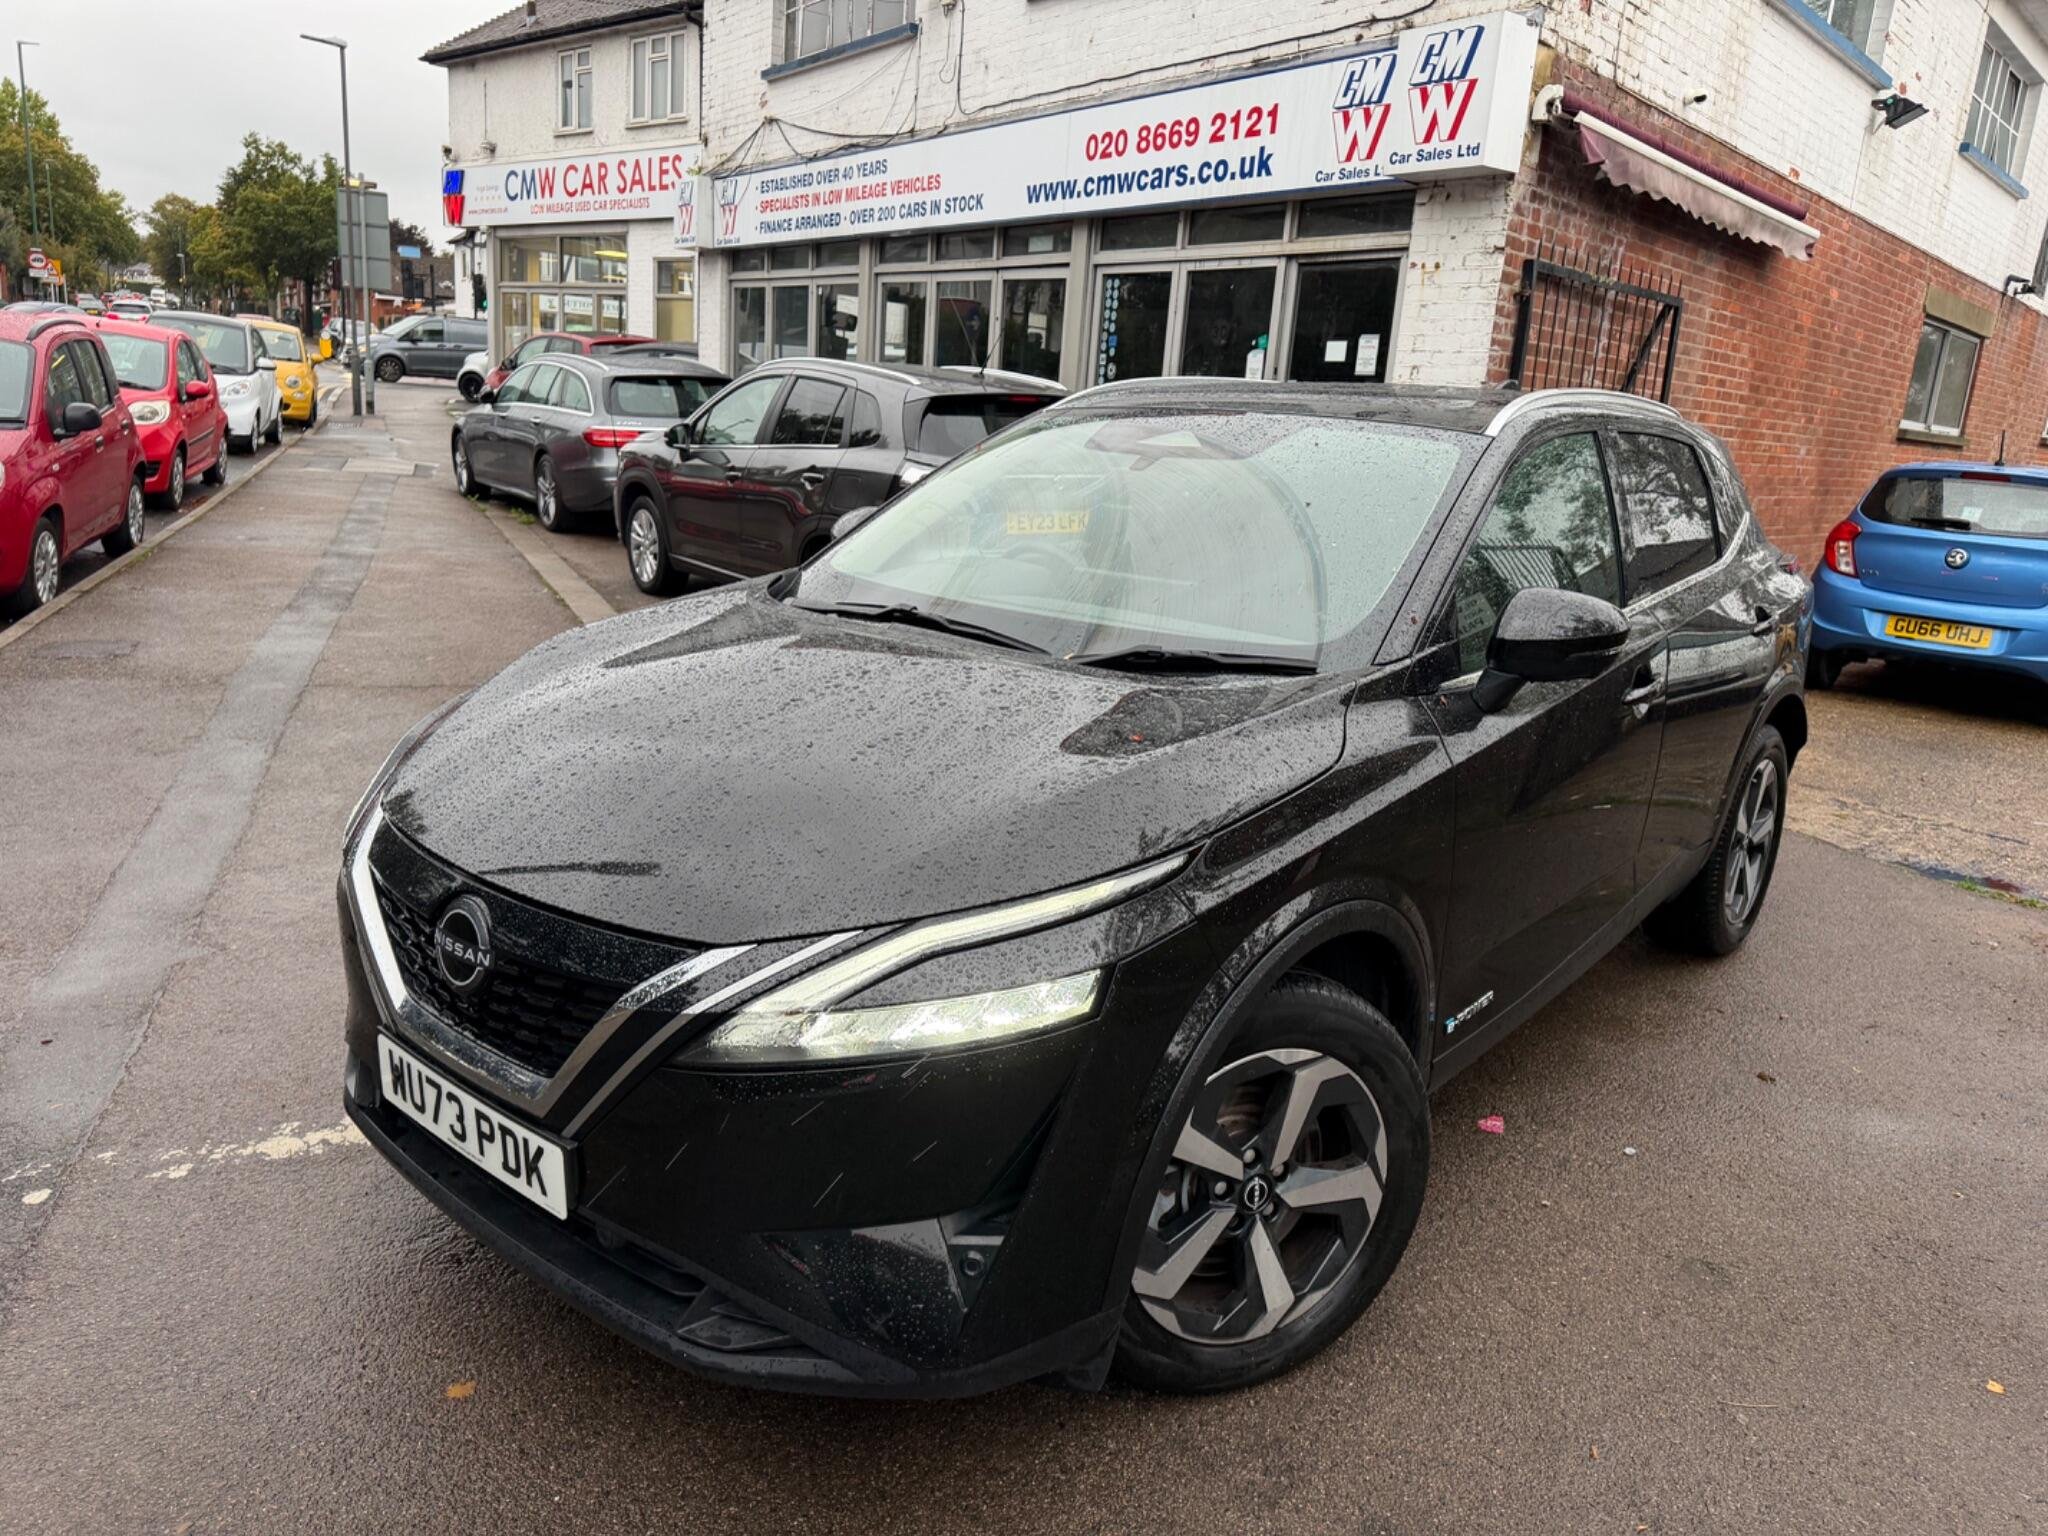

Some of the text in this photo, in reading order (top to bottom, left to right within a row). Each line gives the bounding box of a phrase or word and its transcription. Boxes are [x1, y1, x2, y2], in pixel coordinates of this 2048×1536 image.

[1409, 24, 1485, 86] CM
[1333, 53, 1397, 109] CM
[1085, 103, 1280, 161] 020 8669 2121
[1332, 103, 1391, 163] W
[1408, 77, 1478, 145] W
[1026, 145, 1274, 204] www.cmwcars.co.uk
[1315, 170, 1336, 183] Car
[1337, 167, 1371, 180] Sales
[1389, 142, 1481, 165] Car Sales Ltd
[505, 154, 682, 201] CMW CAR SALES
[759, 174, 942, 214] SPECIALISTS IN LOW MILEAGE VEHICLES
[760, 159, 888, 194] ESTABLISHED OVER 40 YEARS
[575, 200, 591, 213] USED
[592, 199, 608, 211] CAR
[609, 197, 650, 210] SPECIALISTS
[759, 193, 984, 235] FINANCE ARRANGED OVER 200 CARS IN STOCK
[1893, 617, 1984, 644] GU66 UHJ
[434, 926, 491, 968] NISSAN
[474, 1106, 548, 1199] PDK
